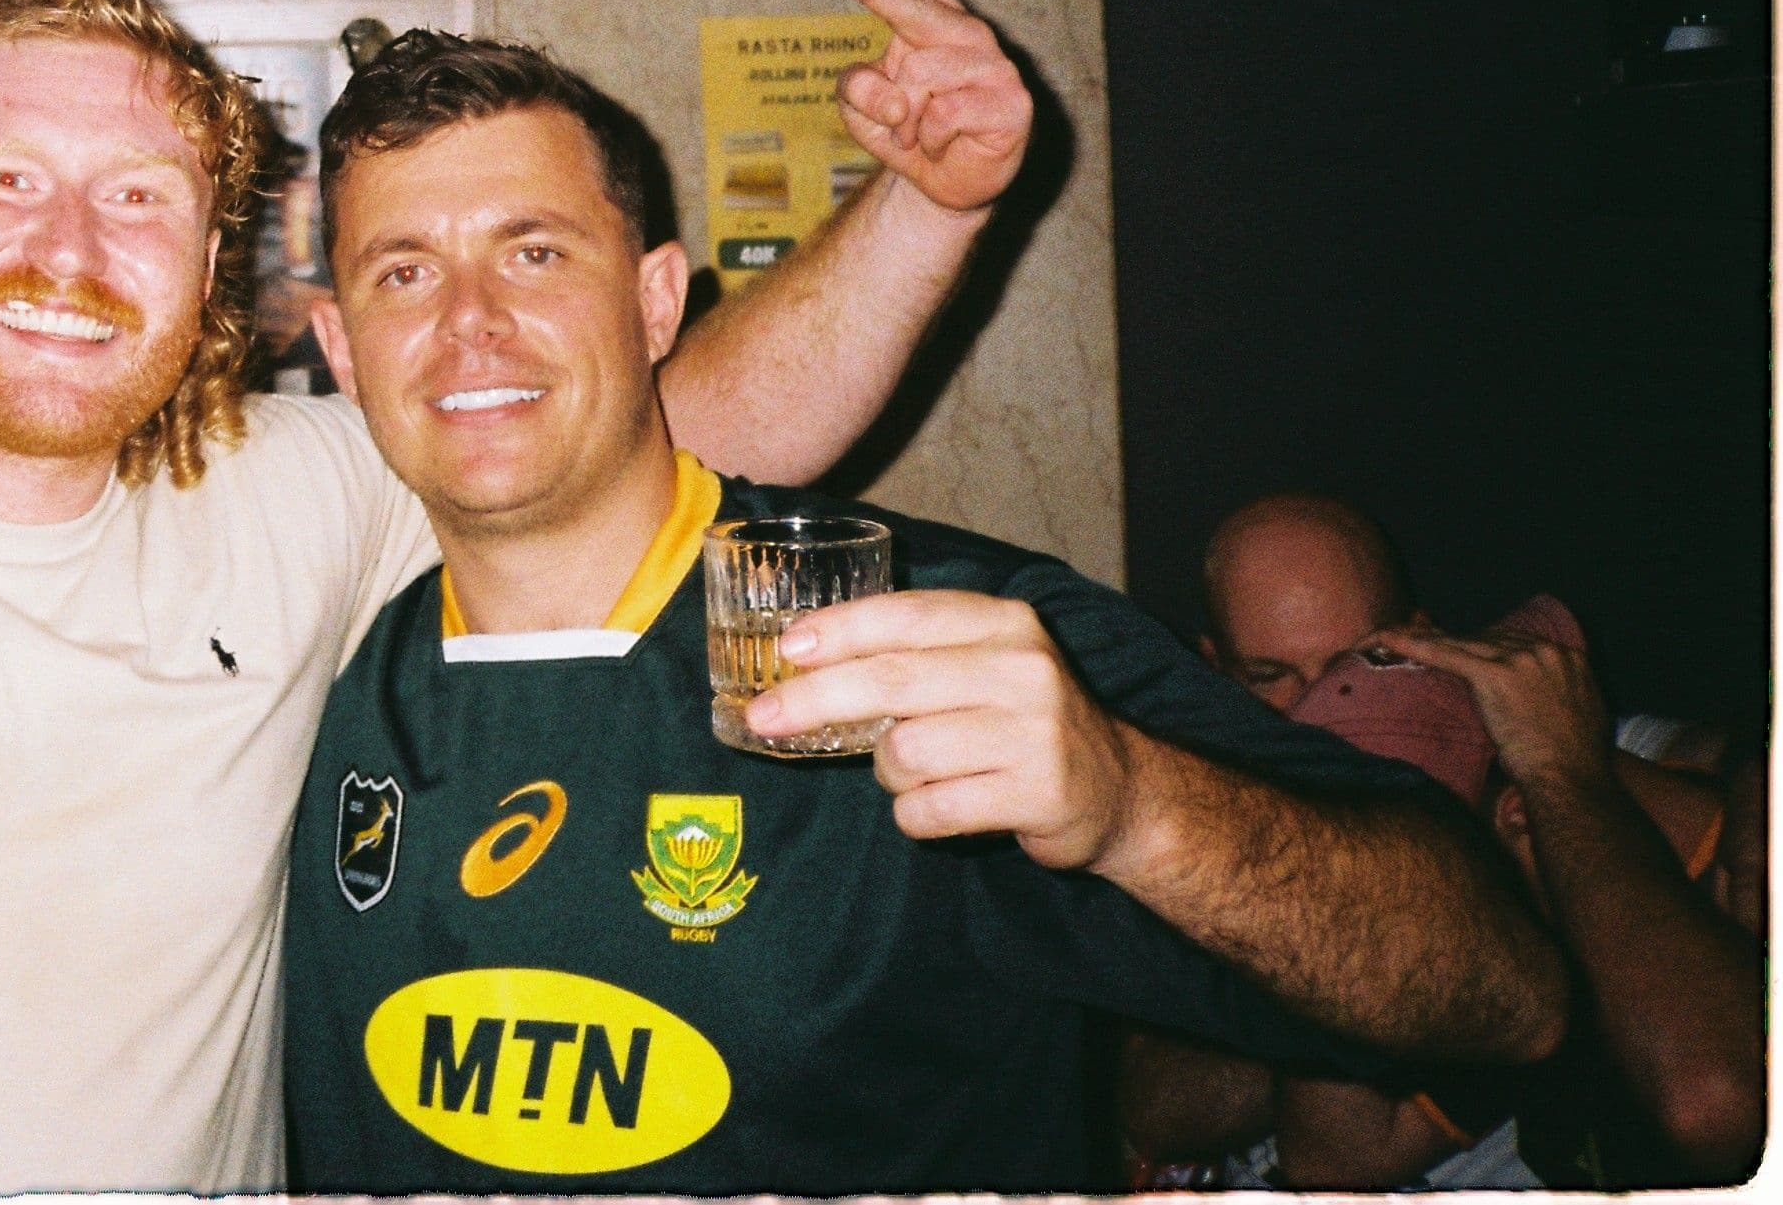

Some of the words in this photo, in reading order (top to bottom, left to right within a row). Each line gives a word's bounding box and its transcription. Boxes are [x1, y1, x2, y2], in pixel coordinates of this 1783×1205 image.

[737, 38, 802, 54] RASTA
[810, 35, 871, 52] RHINO
[670, 928, 717, 943] RUGBY
[418, 1013, 653, 1130] MTN
